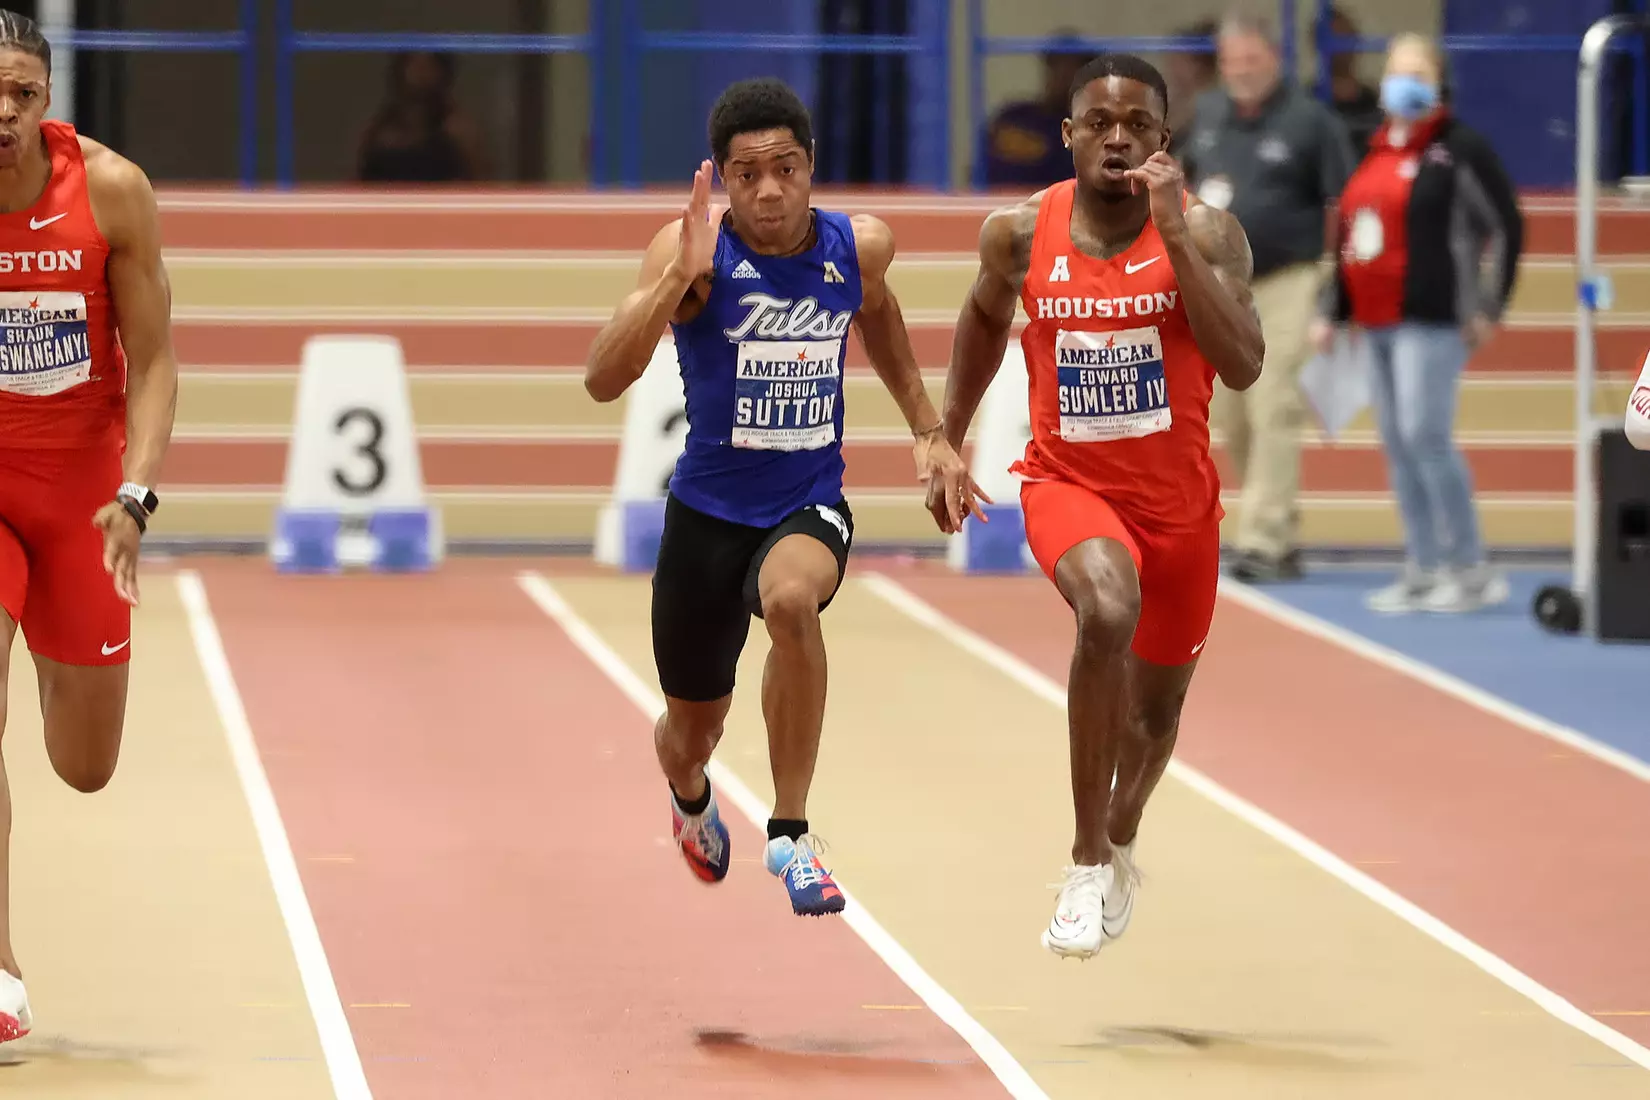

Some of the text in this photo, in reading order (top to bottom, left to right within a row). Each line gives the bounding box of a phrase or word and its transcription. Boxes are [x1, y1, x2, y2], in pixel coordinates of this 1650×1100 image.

[731, 268, 762, 280] adidas
[723, 291, 853, 340] Tulsa
[1036, 291, 1178, 319] HOUSTON
[6, 324, 55, 344] SHAUN
[1060, 344, 1155, 366] AMERICAN
[742, 358, 833, 378] AMERICAN
[1080, 366, 1139, 385] EDWARD
[765, 381, 818, 398] JOSHUA
[1059, 377, 1165, 414] SUMLER IV
[736, 393, 836, 427] SUTTON
[334, 407, 385, 497] 3
